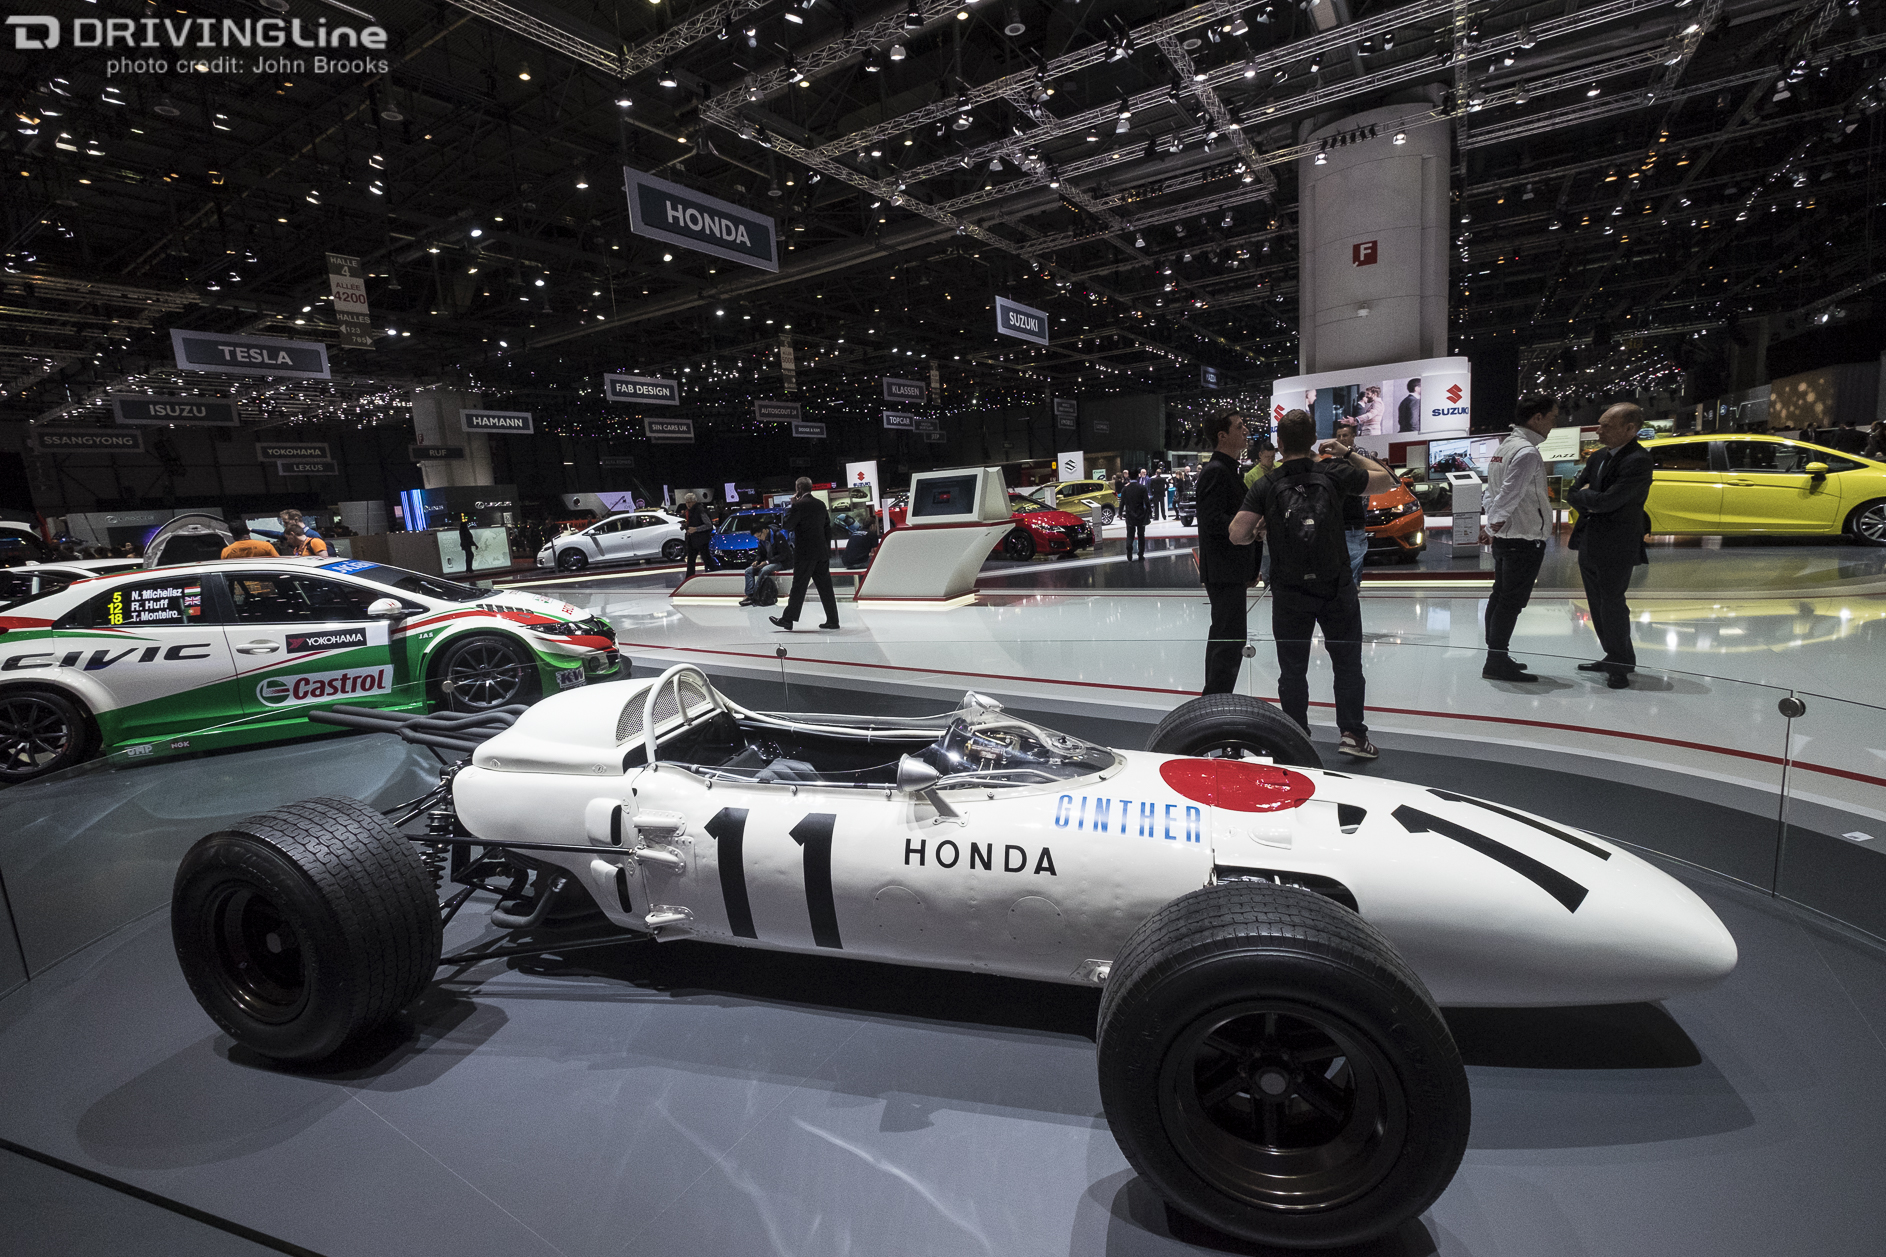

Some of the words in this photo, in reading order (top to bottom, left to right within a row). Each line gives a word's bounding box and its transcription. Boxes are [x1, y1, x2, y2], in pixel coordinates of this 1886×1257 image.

[665, 200, 751, 247] HONDA
[1360, 243, 1373, 260] F
[330, 256, 358, 267] HALLE
[341, 266, 350, 277] 4
[334, 291, 366, 304] 4200
[336, 313, 371, 323] HALLES
[1009, 311, 1038, 332] SUZUKI
[217, 345, 293, 365] TESLA
[616, 383, 634, 394] FAB
[636, 385, 670, 396] DESIGN
[891, 385, 920, 396] KLASSEN
[149, 403, 206, 418] ISUZU
[761, 407, 791, 415] AUTOSCOUT
[1431, 406, 1469, 417] SUZUKI
[472, 416, 523, 428] HAMANN
[889, 416, 910, 425] TOPCAR
[43, 435, 133, 446] SSANGYONG
[266, 447, 322, 456] YOKOHAMA
[429, 449, 447, 457] RUF
[293, 463, 323, 472] LEXUS
[112, 591, 122, 603] 5
[131, 590, 141, 600] N.
[107, 602, 123, 614] 12
[131, 600, 142, 611] R.
[145, 599, 168, 609] Huff
[108, 613, 123, 625] 18
[131, 612, 140, 621] T.
[141, 609, 178, 620] Monteiro
[306, 633, 363, 645] YOKOHAMA
[1, 643, 211, 672] CIVIC
[560, 668, 584, 684] KW
[292, 669, 386, 700] Castrol
[171, 741, 190, 749] NGK
[1054, 794, 1201, 843] GINTHER
[904, 838, 1057, 877] HONDA
[703, 806, 843, 950] 11
